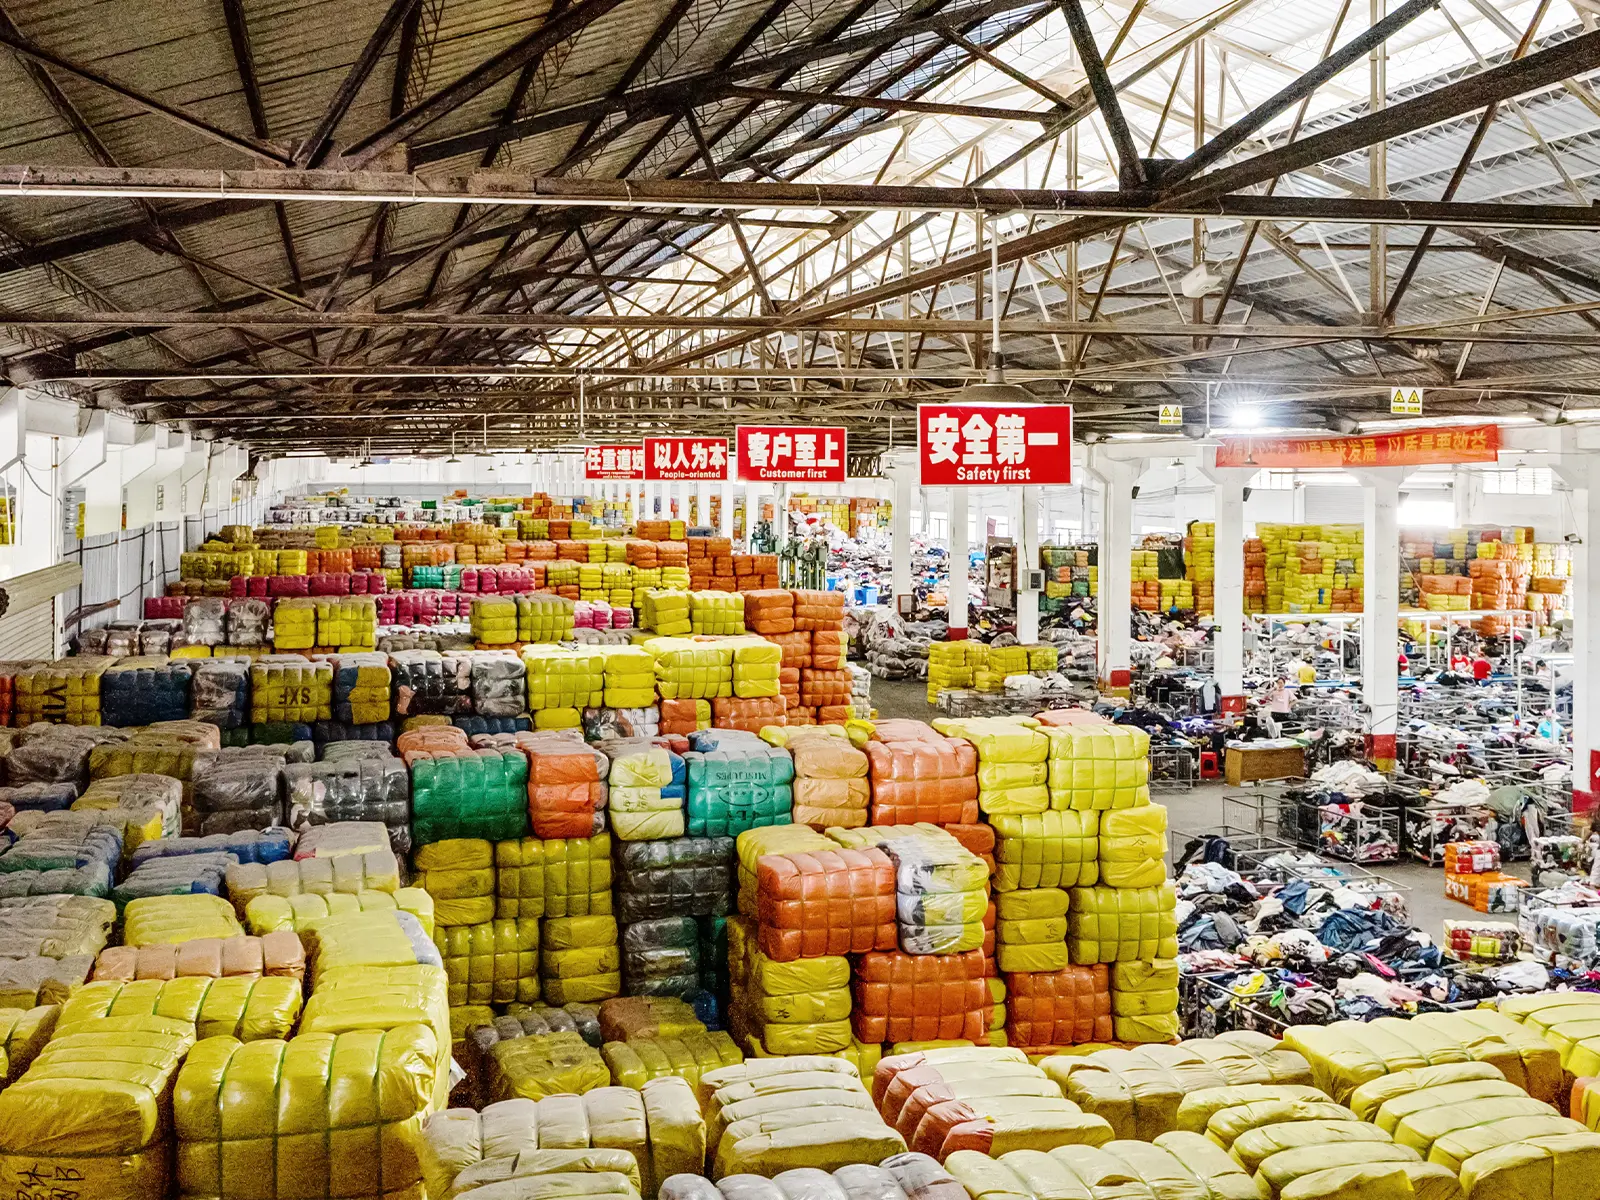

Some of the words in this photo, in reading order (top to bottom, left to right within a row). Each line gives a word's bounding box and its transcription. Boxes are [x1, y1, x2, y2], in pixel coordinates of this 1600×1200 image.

[927, 413, 1059, 465] 安全第一
[586, 448, 643, 472] 任重道远
[653, 442, 727, 470] 以人为本
[747, 432, 840, 468] 客户至上
[660, 470, 721, 479] People-oriented
[760, 468, 806, 478] Customer
[807, 468, 827, 478] first
[956, 466, 1000, 483] Safety
[1002, 466, 1031, 480] first
[278, 686, 311, 705] SXF
